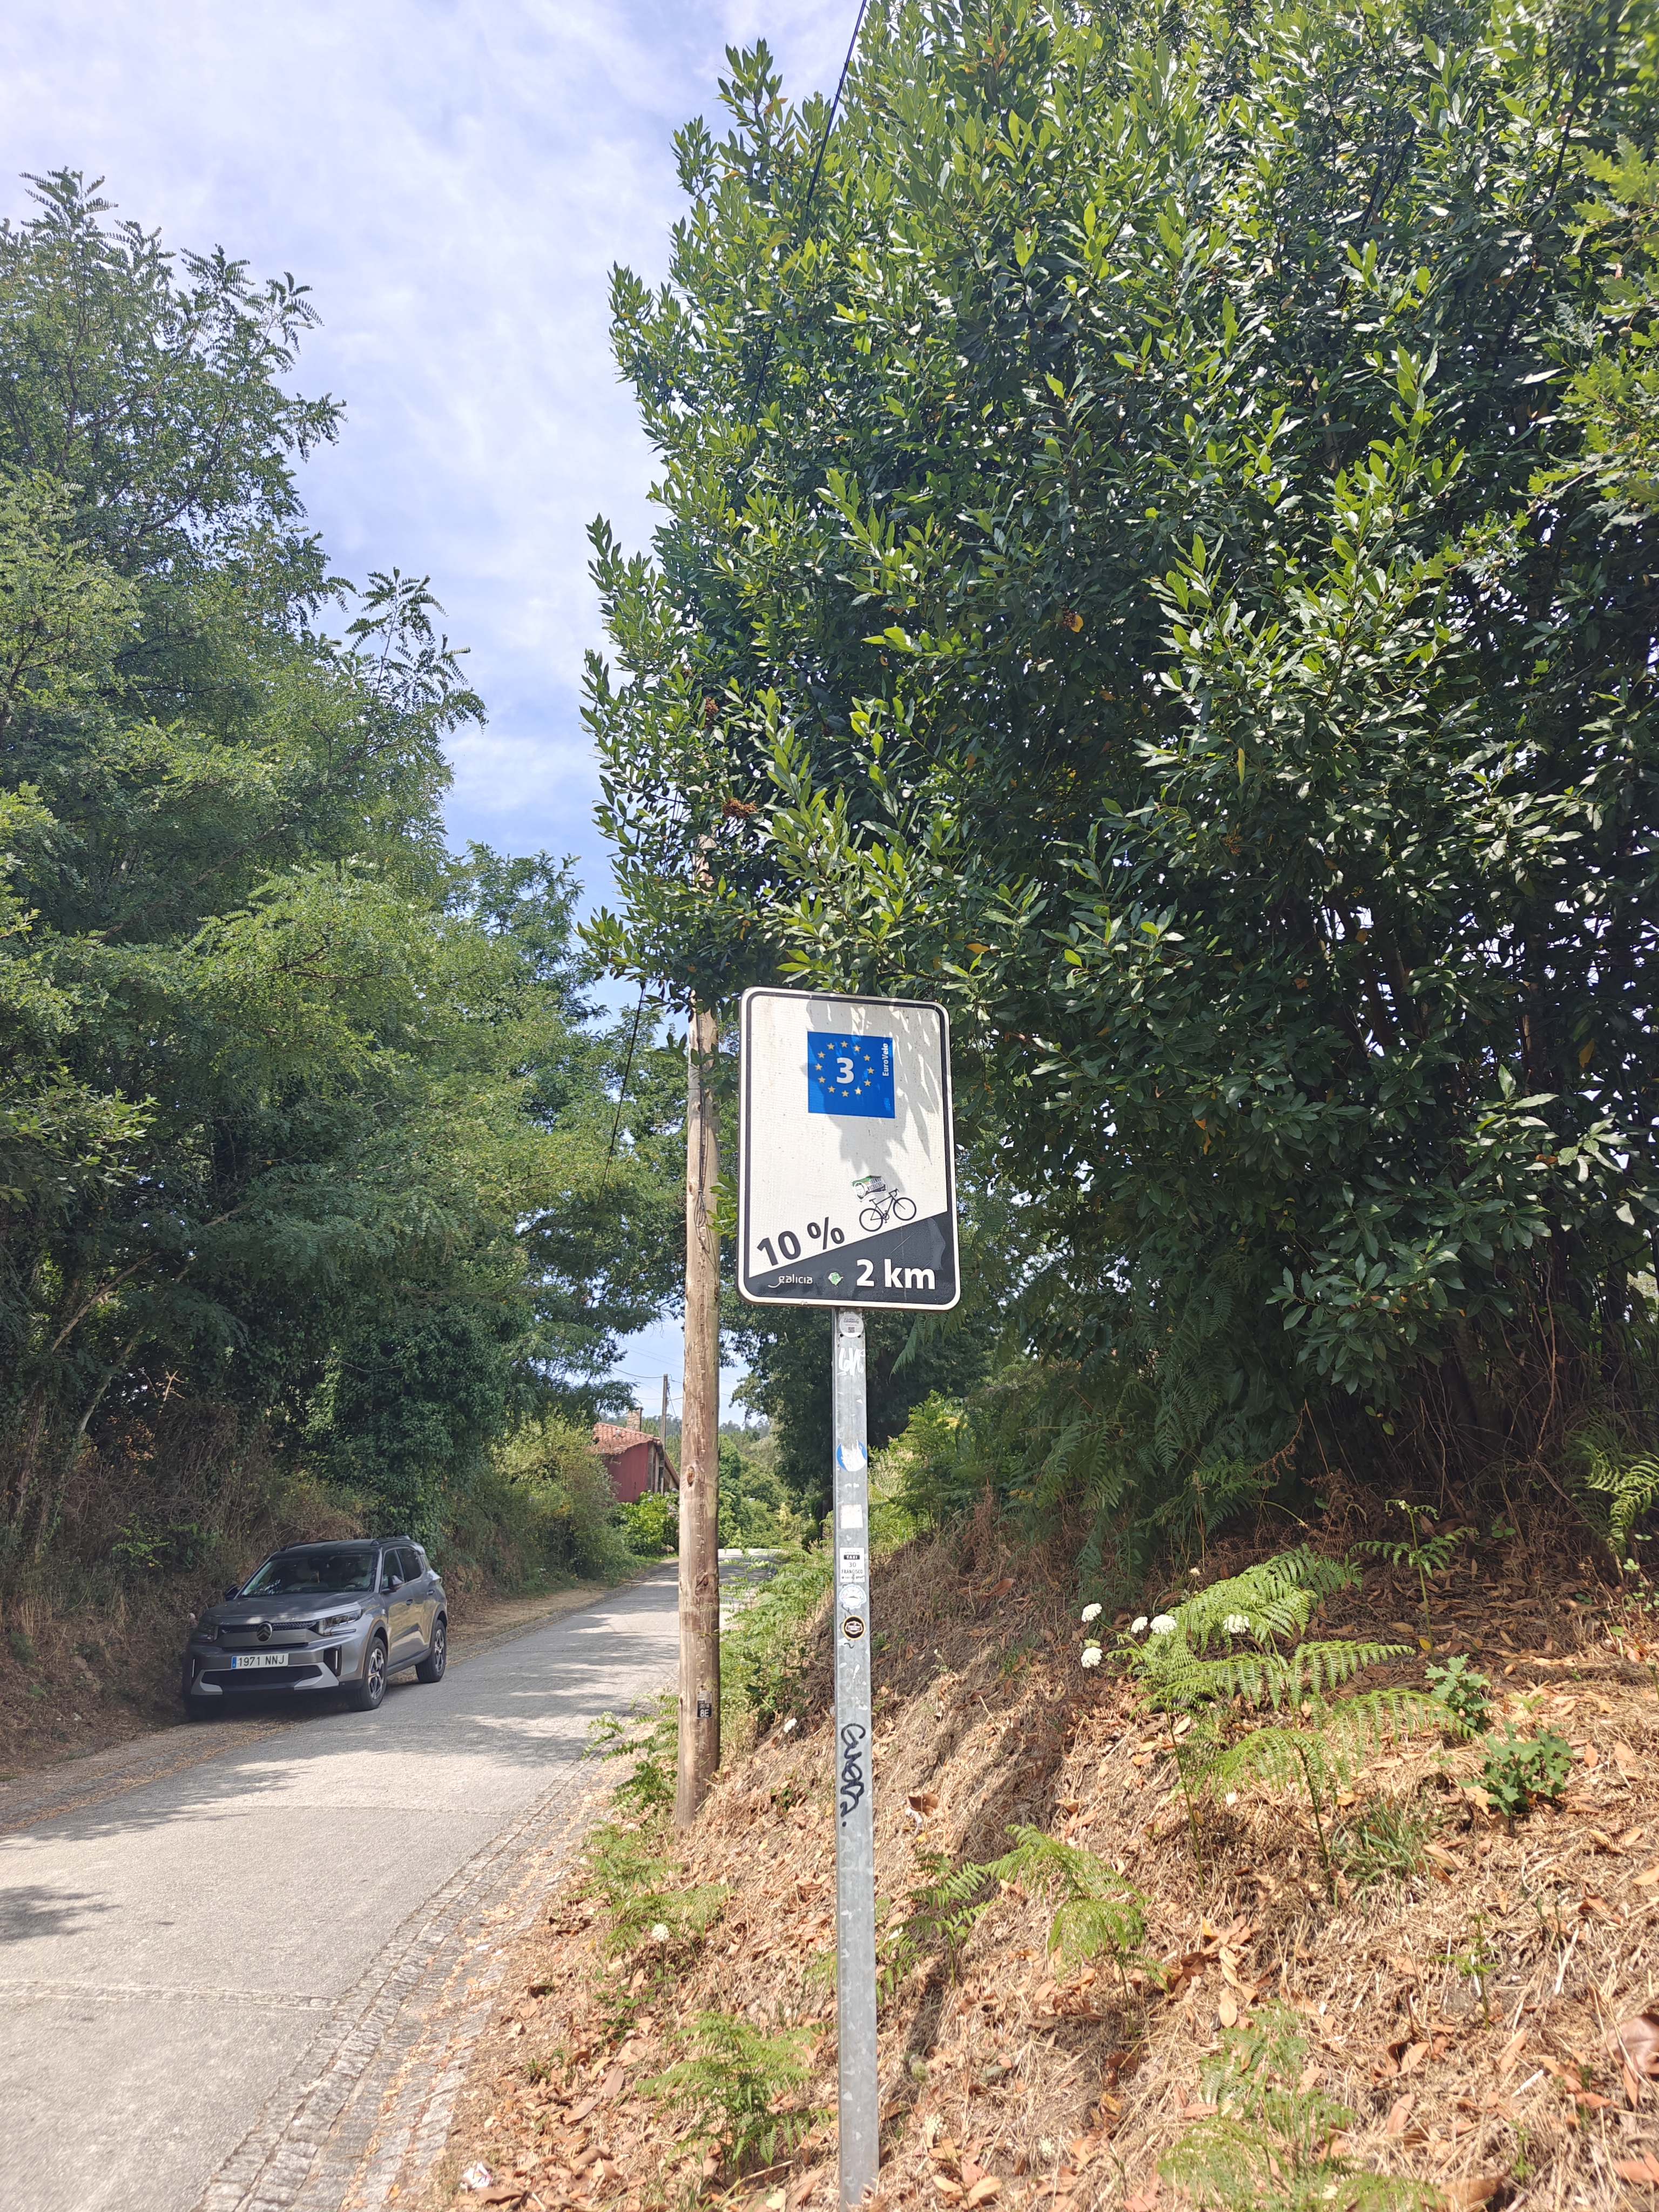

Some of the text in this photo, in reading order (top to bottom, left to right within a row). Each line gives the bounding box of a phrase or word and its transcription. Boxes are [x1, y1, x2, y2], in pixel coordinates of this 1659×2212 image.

[836, 1057, 855, 1084] 3
[881, 1043, 889, 1076] EuroVelo
[757, 1216, 845, 1266] 10 %
[768, 1273, 813, 1288] galicia
[856, 1258, 935, 1290] 2 km
[239, 1655, 285, 1667] 1971 NNJ
